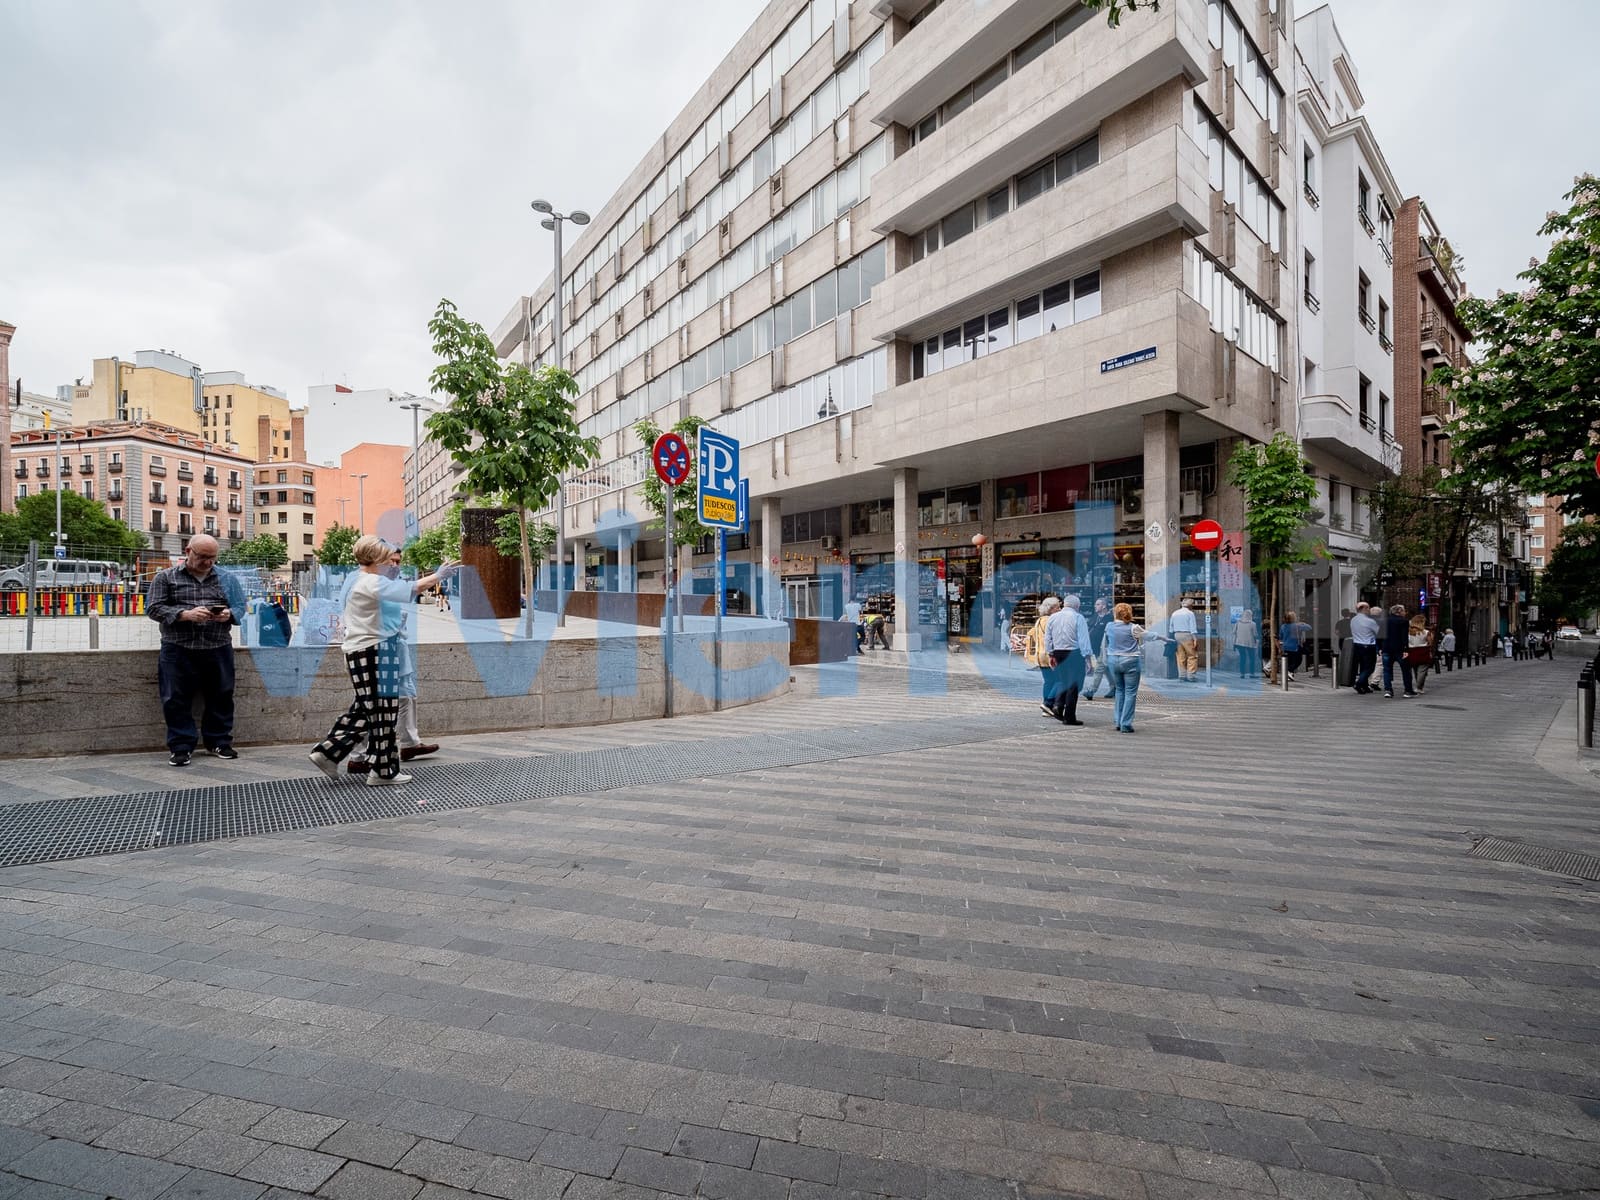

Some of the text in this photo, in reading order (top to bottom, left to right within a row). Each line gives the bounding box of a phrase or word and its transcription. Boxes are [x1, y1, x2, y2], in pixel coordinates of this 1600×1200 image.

[704, 442, 733, 491] P
[704, 499, 736, 512] TUDESCOS
[1220, 540, 1242, 561] 和
